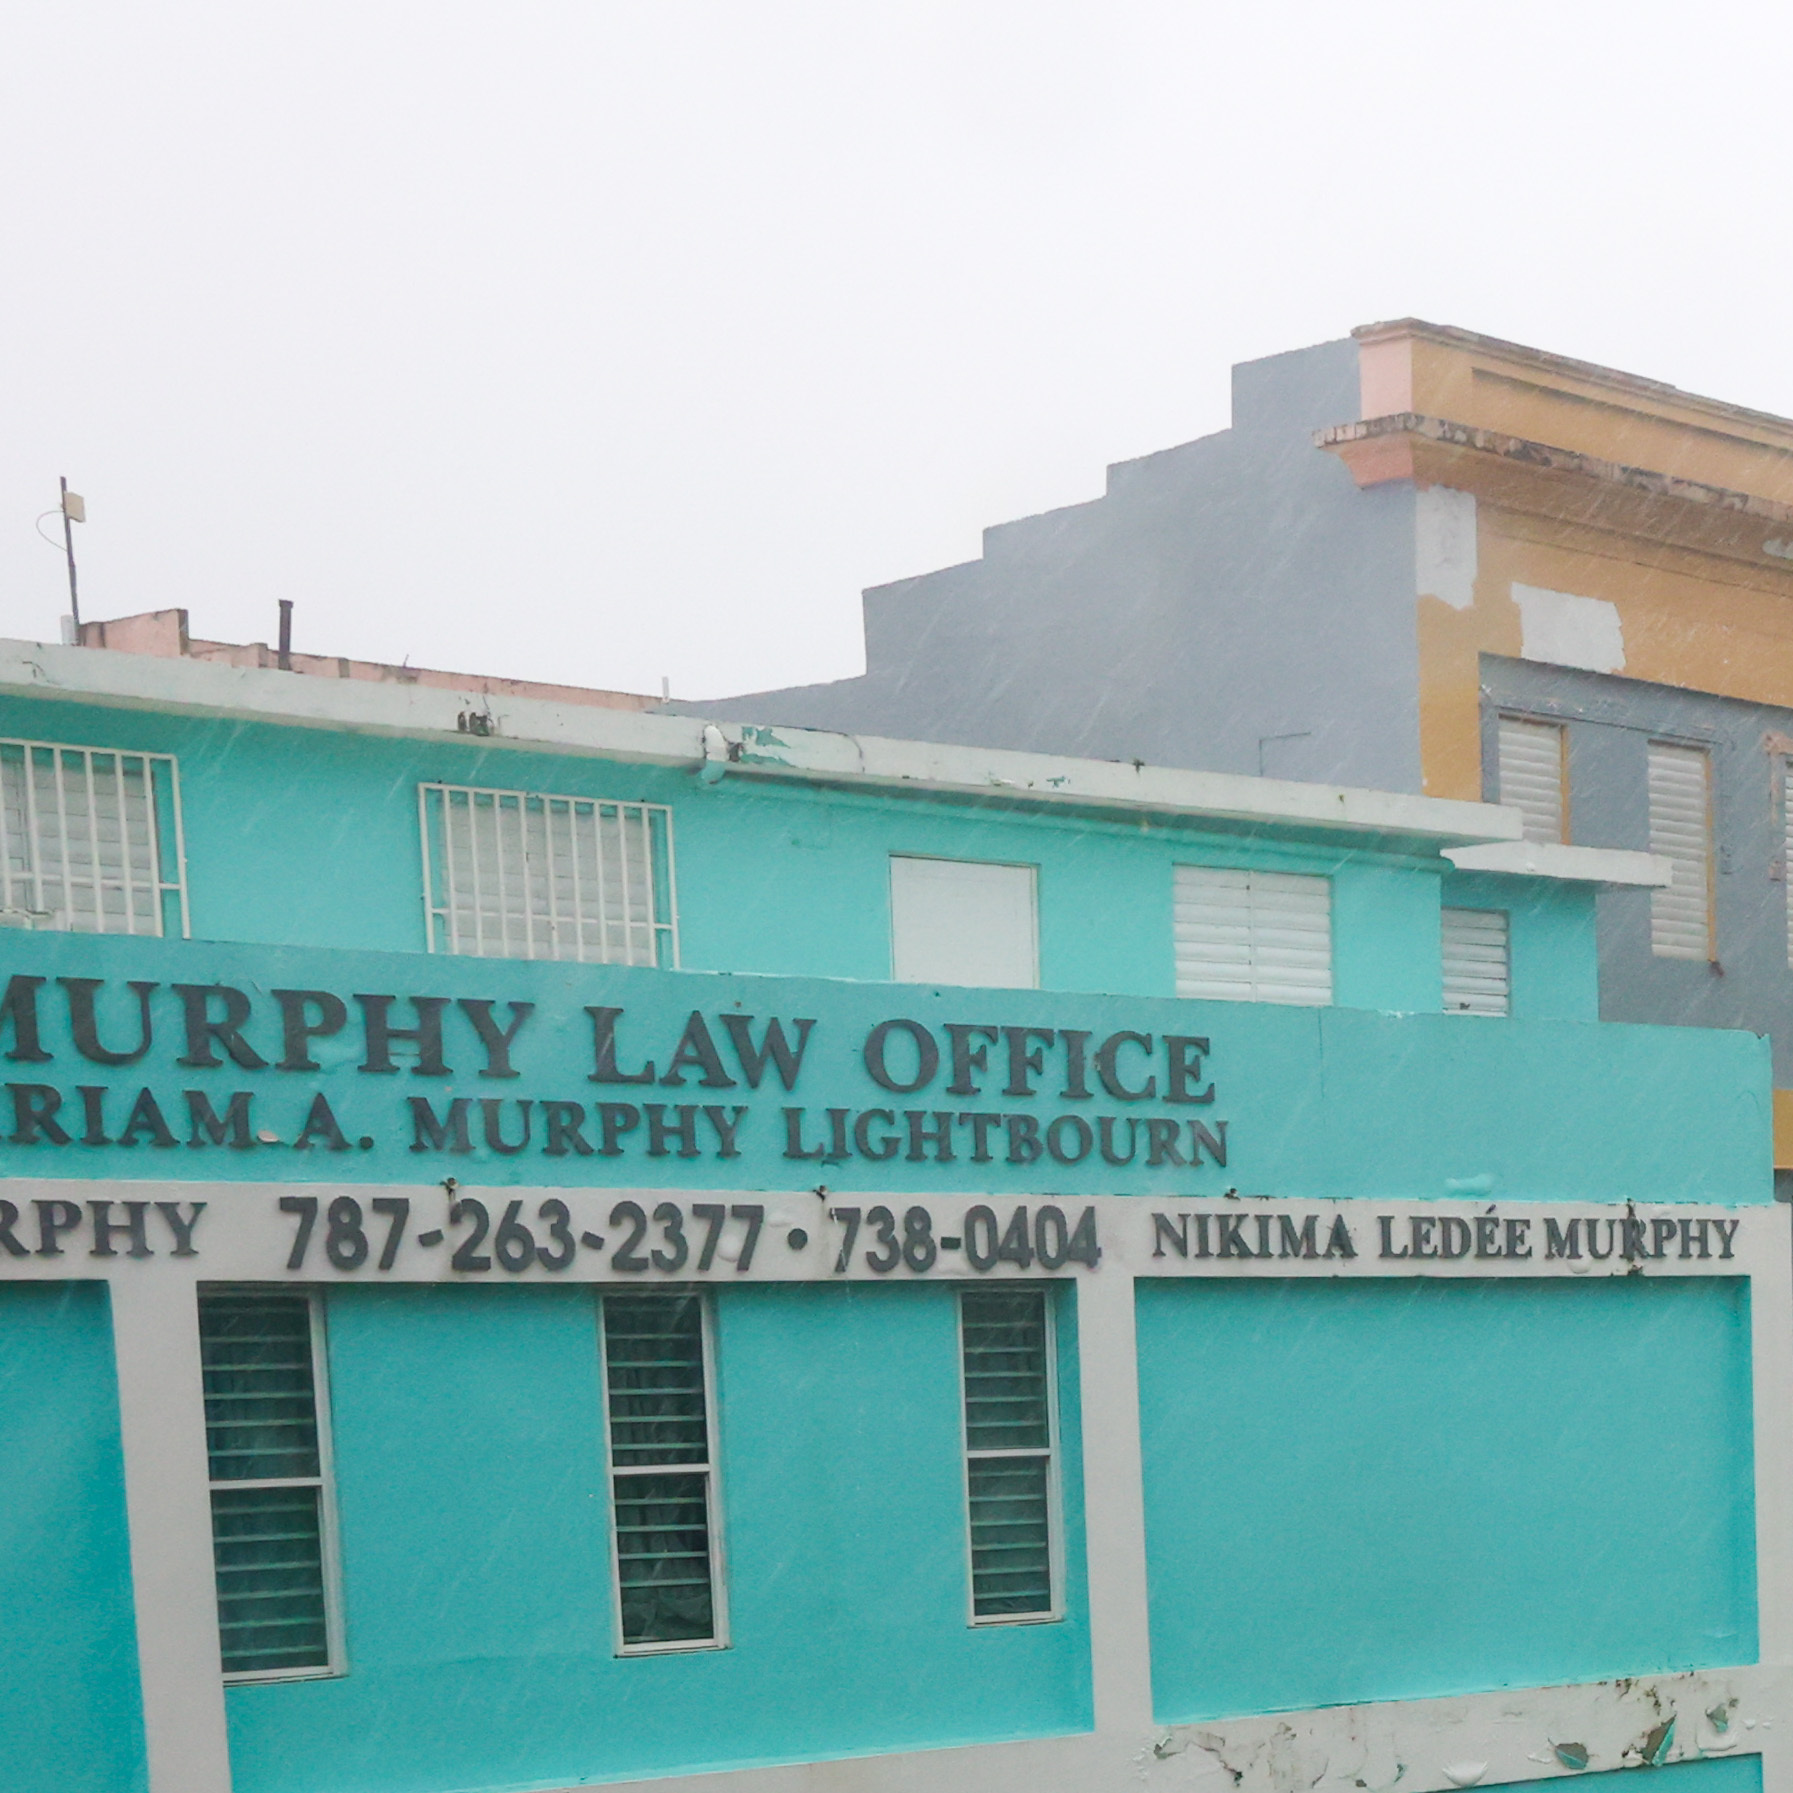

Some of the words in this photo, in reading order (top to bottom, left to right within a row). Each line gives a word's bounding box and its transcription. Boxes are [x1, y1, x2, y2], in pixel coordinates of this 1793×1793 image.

[0, 974, 535, 1078] MURPHY
[584, 1006, 817, 1091] LAW
[864, 1018, 1216, 1103] OFFICE
[0, 1083, 258, 1148] RIAM
[293, 1092, 374, 1150] A.
[406, 1096, 749, 1158] MURPHY
[781, 1106, 1229, 1167] LIGHTBOURN
[279, 1195, 765, 1273] 787-263-2377
[829, 1204, 1102, 1273] 738-0404
[1151, 1212, 1359, 1260] NIKIMA
[1376, 1203, 1533, 1260] LEDÉE
[1543, 1216, 1740, 1260] MURPHY
